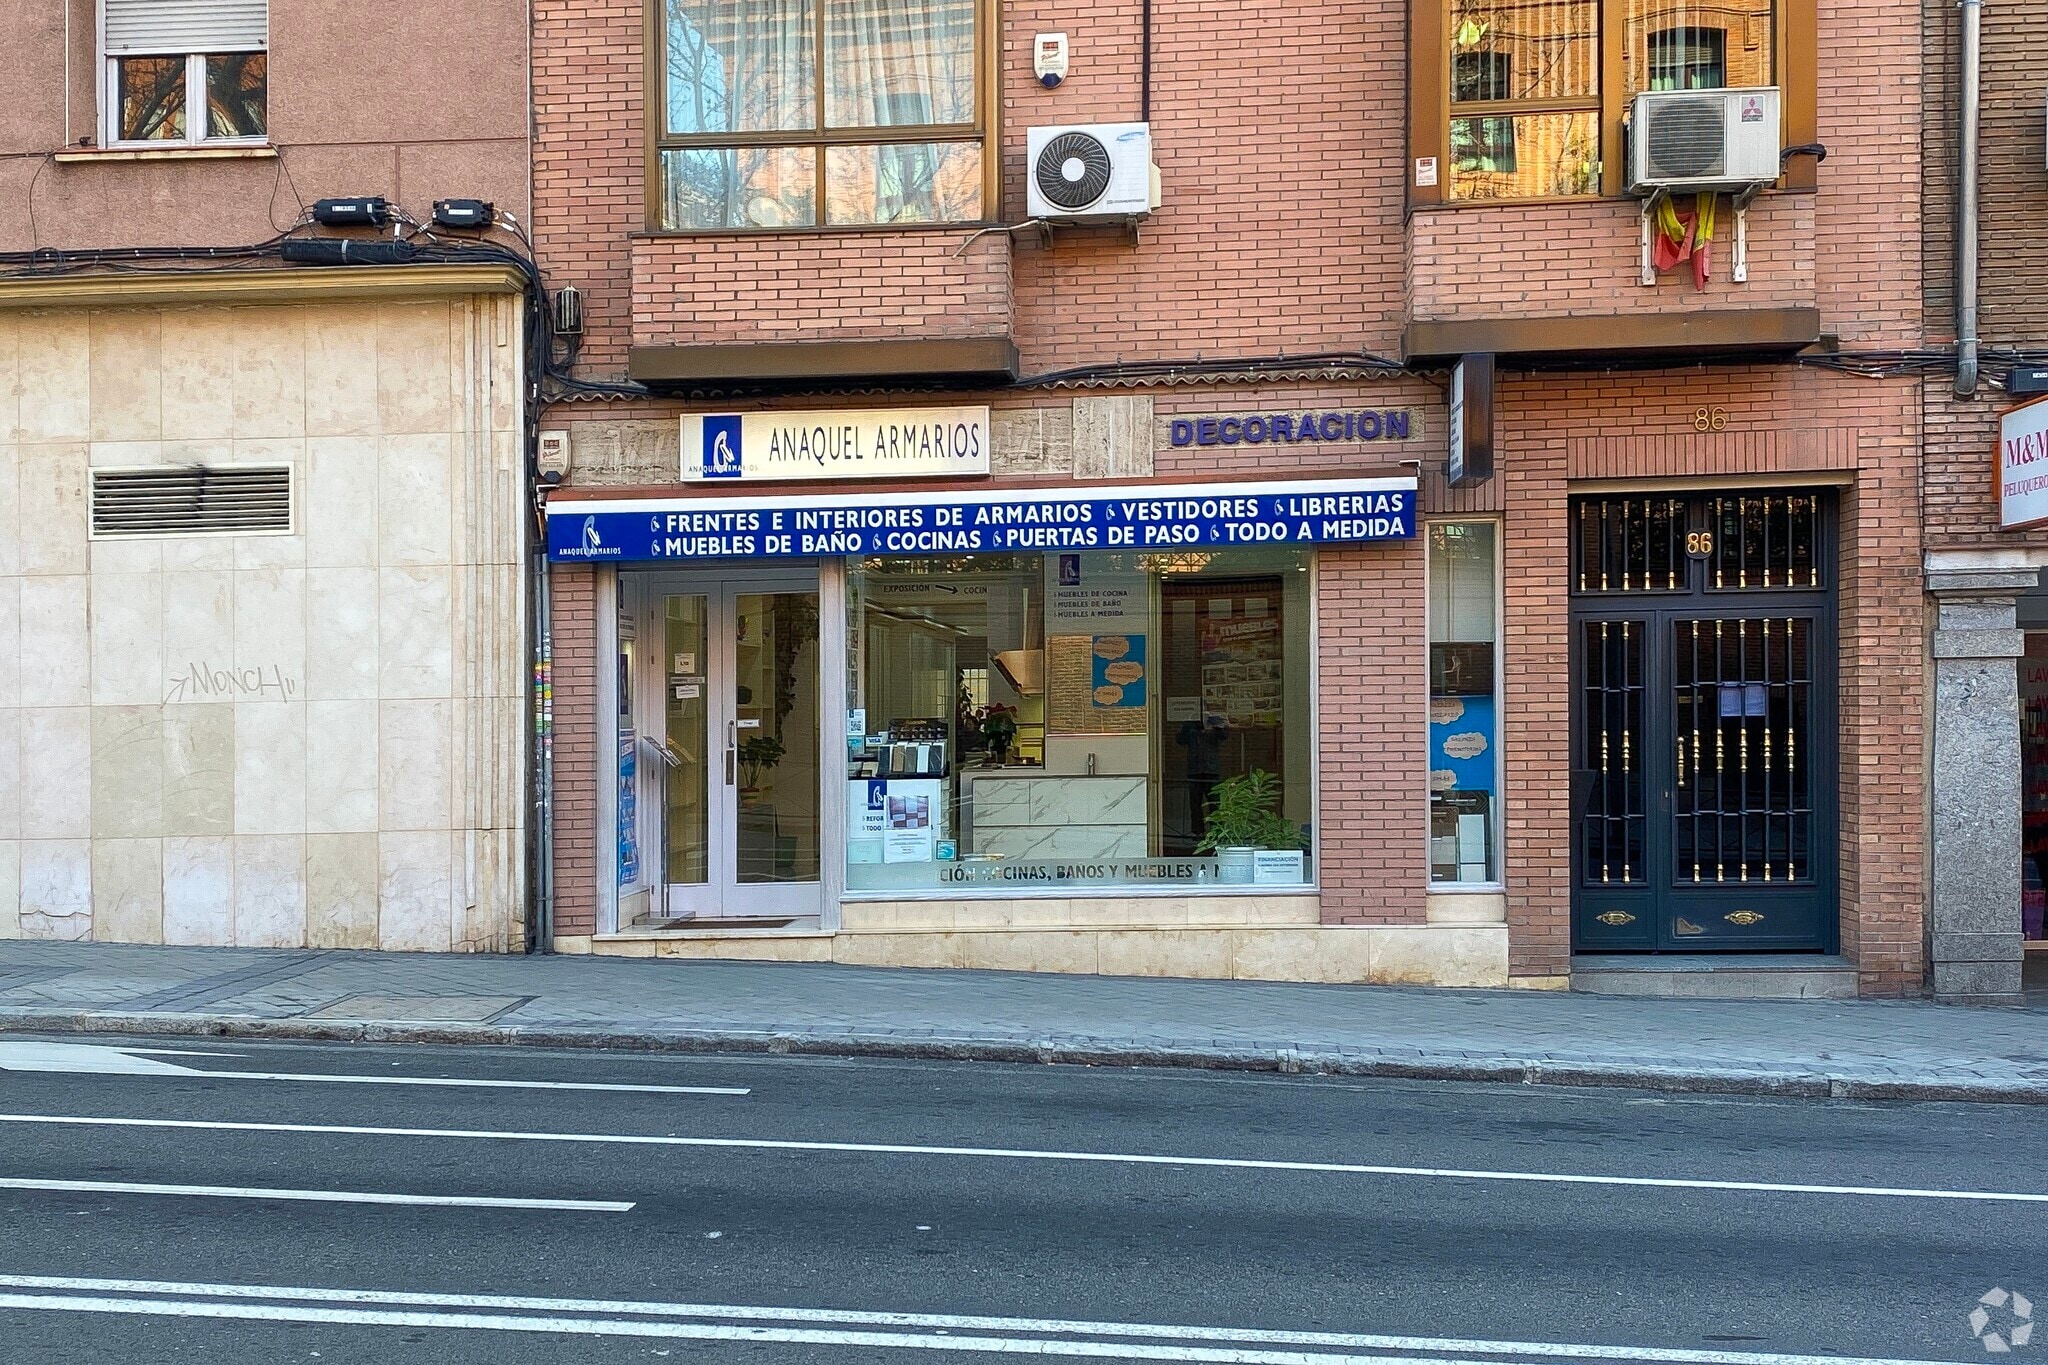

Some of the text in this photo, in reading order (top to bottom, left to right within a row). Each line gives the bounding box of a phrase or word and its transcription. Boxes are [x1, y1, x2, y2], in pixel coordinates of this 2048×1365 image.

[1170, 411, 1409, 447] DECORACION
[1695, 406, 1726, 431] 86
[768, 422, 981, 465] ANAQUEL ARMARIOS
[666, 493, 1403, 533] FRENTES E INTERIORES DE ARMARIOS VESTIDORES LIBRERIAS
[665, 516, 1406, 556] MUEBLES DE BAÑO COCINAS PUERTAS DE PASO TODO A MEDIDA
[1687, 532, 1712, 554] 86
[883, 582, 930, 593] EXPOSICIÓN
[1058, 590, 1088, 598] MUEBLES
[1102, 599, 1121, 607] BAÑO
[1056, 863, 1105, 879] BAÑOS
[1108, 865, 1119, 878] Y
[1125, 864, 1193, 879] MUEBLES
